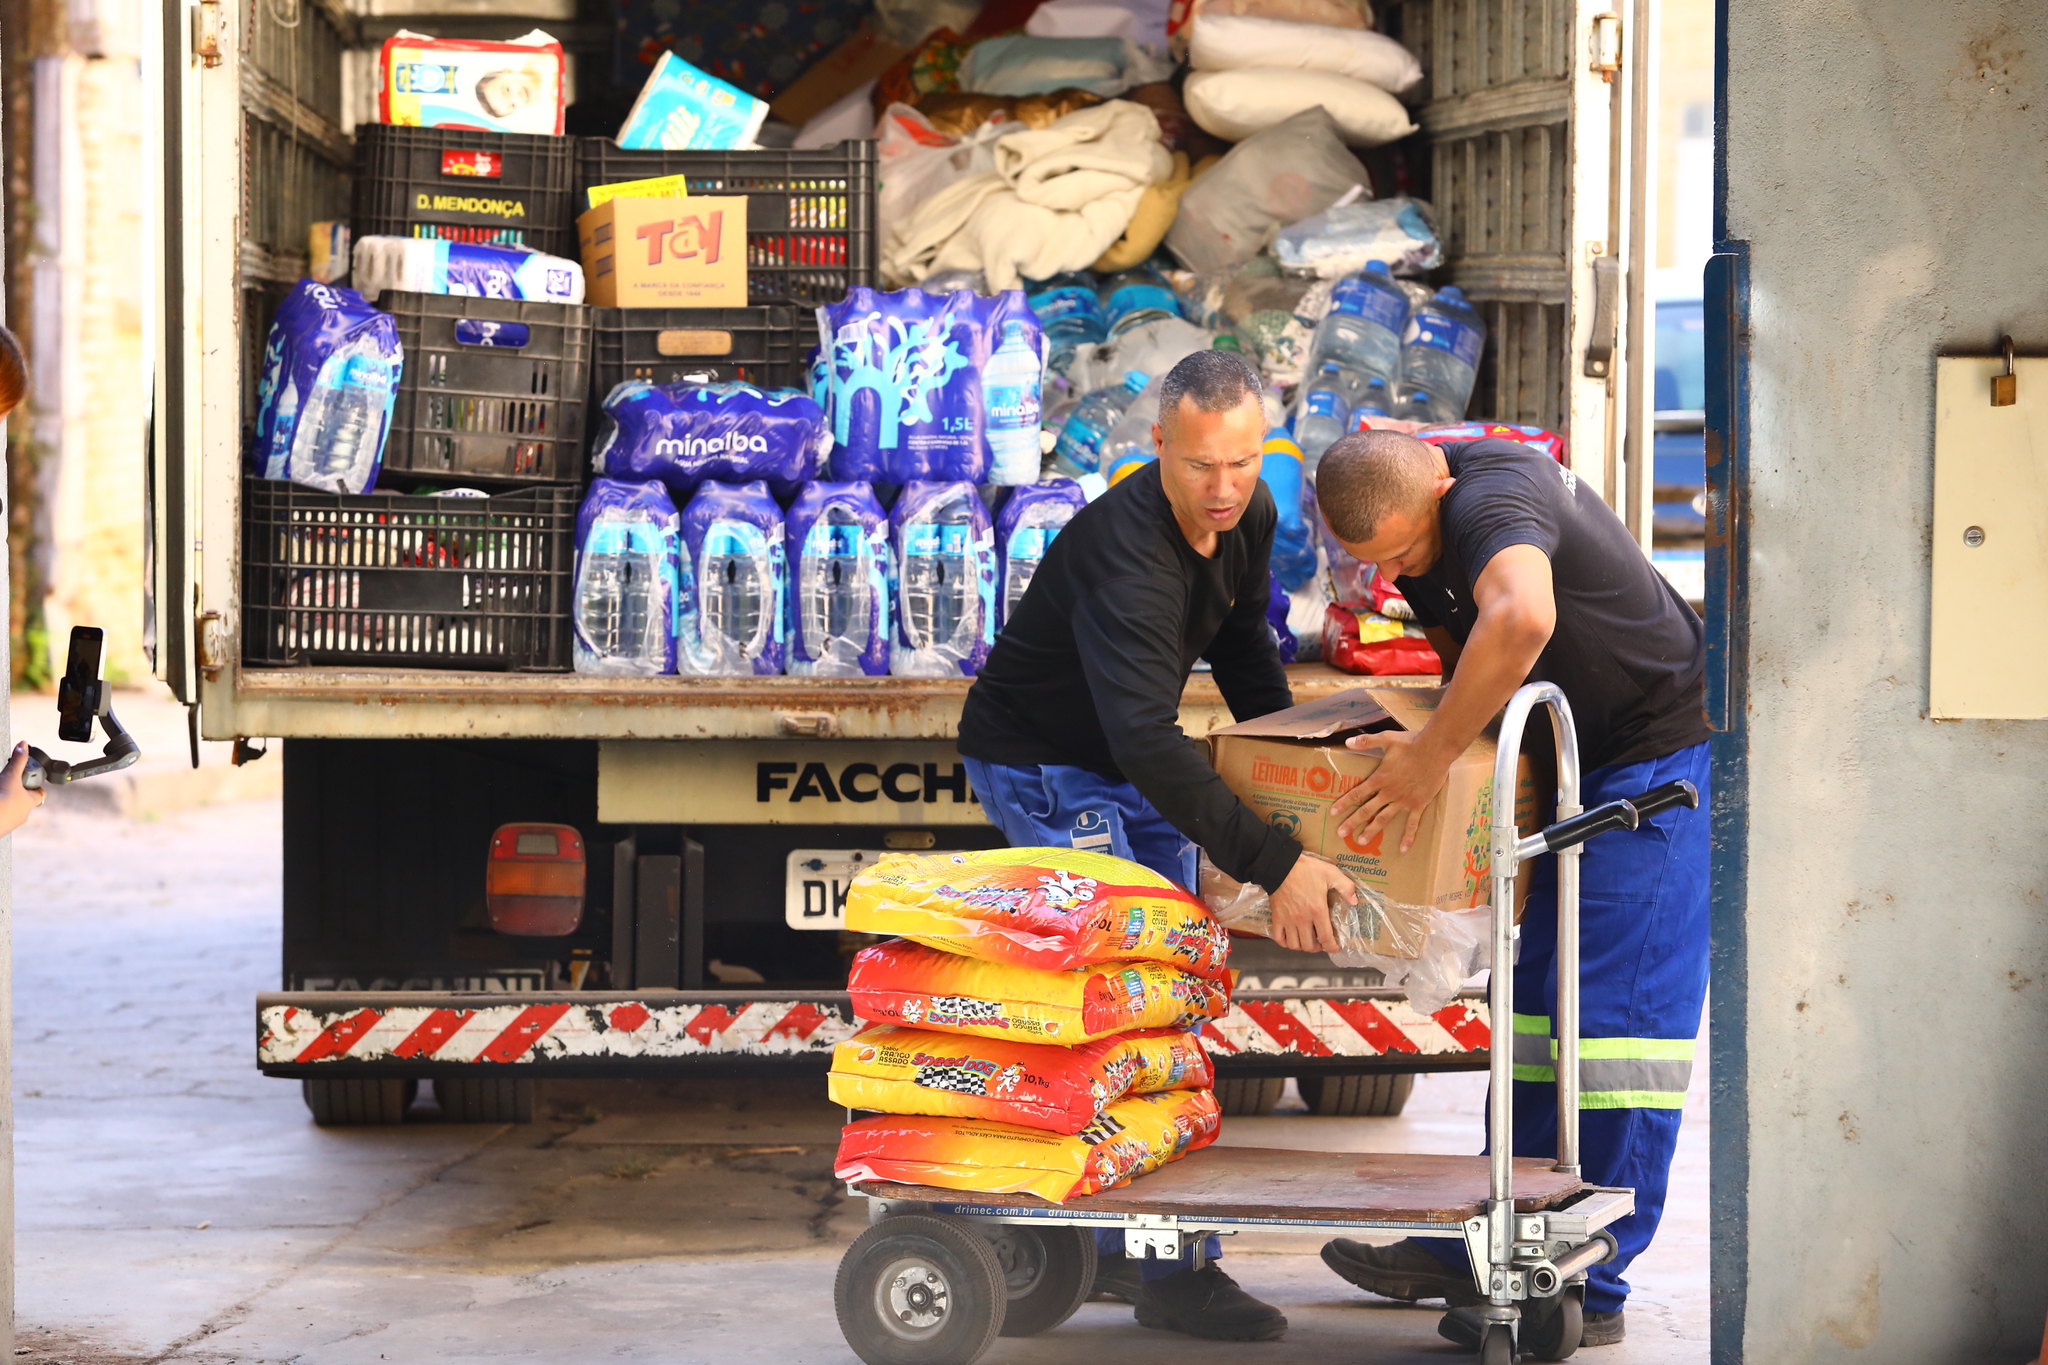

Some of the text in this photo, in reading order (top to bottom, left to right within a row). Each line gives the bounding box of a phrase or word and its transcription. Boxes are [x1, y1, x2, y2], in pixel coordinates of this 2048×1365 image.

[416, 194, 525, 218] D. MENDONÇA
[655, 432, 768, 456] minalba
[1251, 761, 1299, 788] LEITURA
[1336, 853, 1380, 866] qualidade
[929, 1011, 1010, 1029] Speed DOG
[879, 1056, 909, 1065] ASSADO
[880, 1050, 910, 1059] FRANGO
[911, 1052, 969, 1068] Speed
[965, 1062, 996, 1075] DOG
[1024, 1073, 1050, 1088] 10,1kg
[1035, 1138, 1062, 1147] ALIMENTO
[955, 1205, 1034, 1217] drimec.com.br
[1048, 1208, 1123, 1219] drimec.com.b
